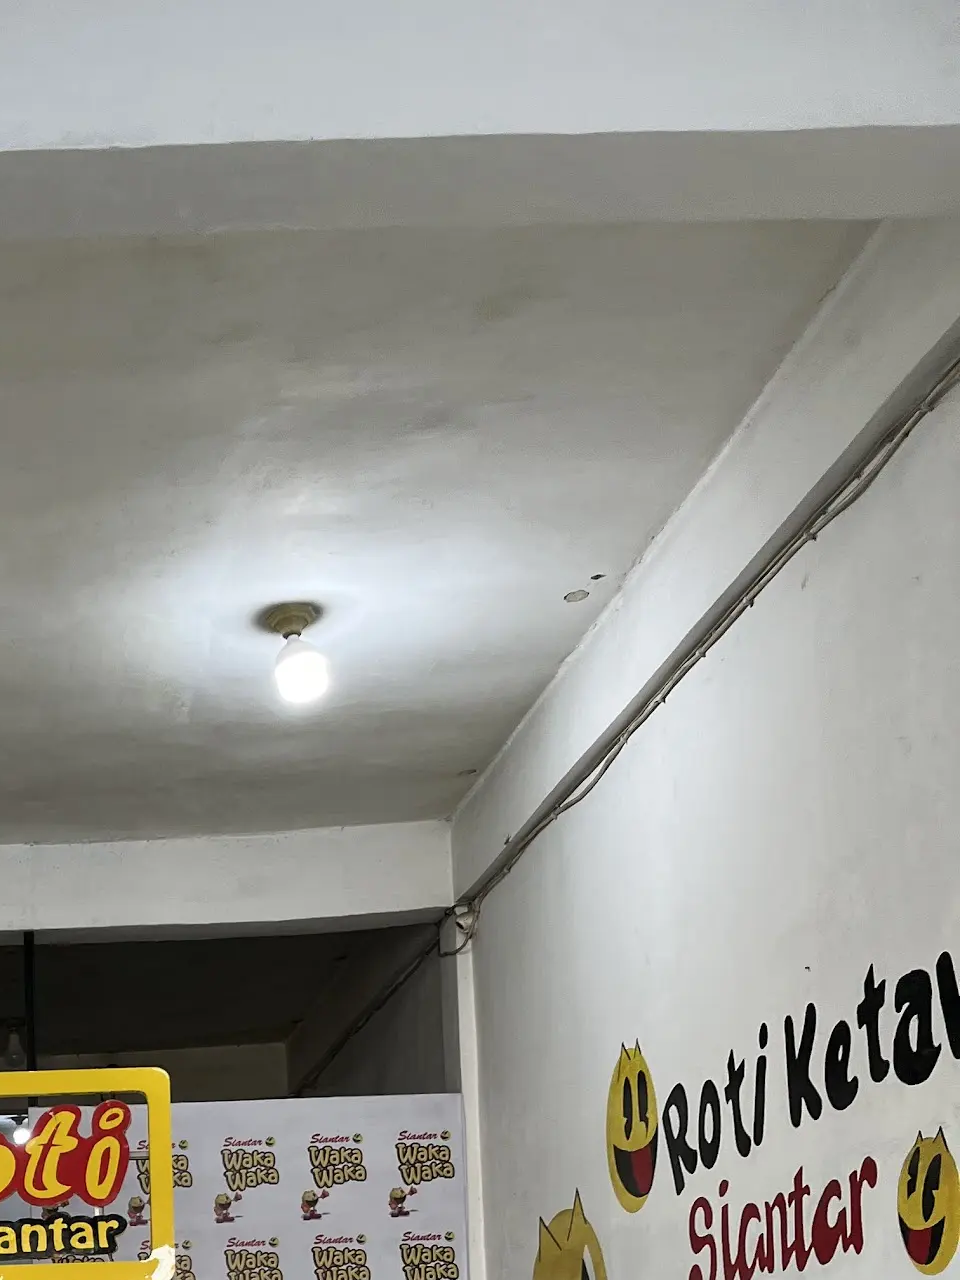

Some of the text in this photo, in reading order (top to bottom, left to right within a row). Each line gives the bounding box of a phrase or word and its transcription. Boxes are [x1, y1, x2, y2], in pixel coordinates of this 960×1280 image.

[662, 1023, 768, 1195] Roti
[223, 1136, 263, 1148] Siantar
[310, 1133, 351, 1145] Siantar
[397, 1130, 438, 1141] Siantar
[221, 1149, 276, 1171] Waka
[308, 1145, 363, 1168] Waka
[395, 1142, 451, 1164] Waka
[225, 1168, 280, 1192] Waka
[311, 1165, 367, 1189] Waka
[400, 1161, 455, 1185] Waka
[226, 1237, 267, 1248] Siantar
[314, 1233, 354, 1245] Siantar
[401, 1231, 442, 1242] Siantar
[225, 1249, 279, 1272] Waka
[312, 1246, 367, 1269] Waka
[400, 1243, 455, 1265] Waka
